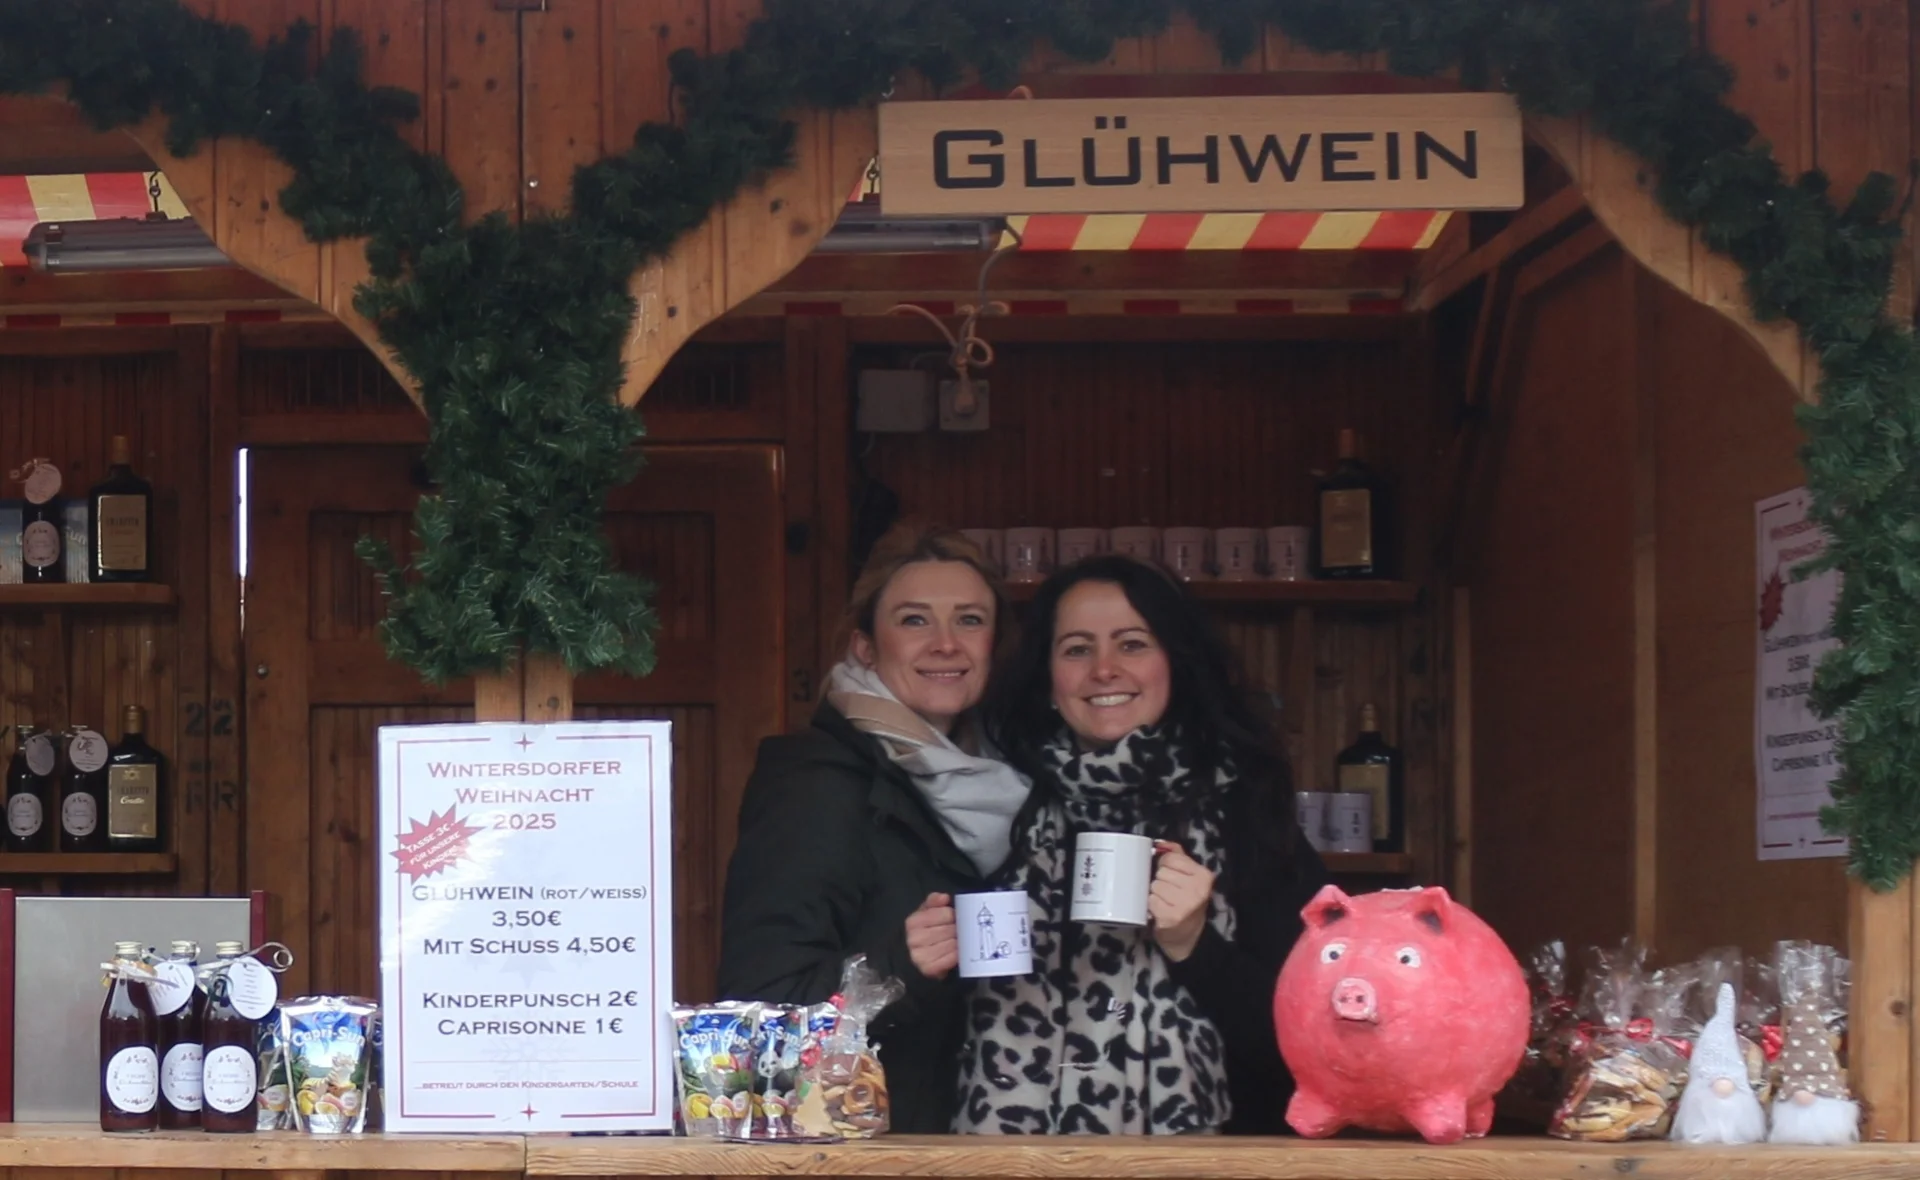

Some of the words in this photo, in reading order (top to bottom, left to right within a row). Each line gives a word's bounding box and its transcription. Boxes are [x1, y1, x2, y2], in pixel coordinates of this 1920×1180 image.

[933, 115, 1478, 190] GLÜHWEIN
[427, 761, 621, 778] WINTERSDORFER
[455, 787, 594, 805] WEIHNACHT
[493, 813, 557, 830] 2025
[412, 884, 533, 902] GLÜHWEIN
[540, 885, 647, 902] (ROT/WEISS)
[492, 910, 562, 930] 3,50€
[423, 938, 464, 955] MIT
[470, 937, 559, 955] SCHUSS
[566, 936, 636, 957] 4,50€
[422, 992, 601, 1009] KINDERPUNSCH
[607, 990, 638, 1008] 2€
[438, 1018, 586, 1036] CAPRISONNE
[290, 1025, 367, 1048] Capri-Sun
[466, 1081, 498, 1090] DURCH
[500, 1081, 519, 1089] DEN
